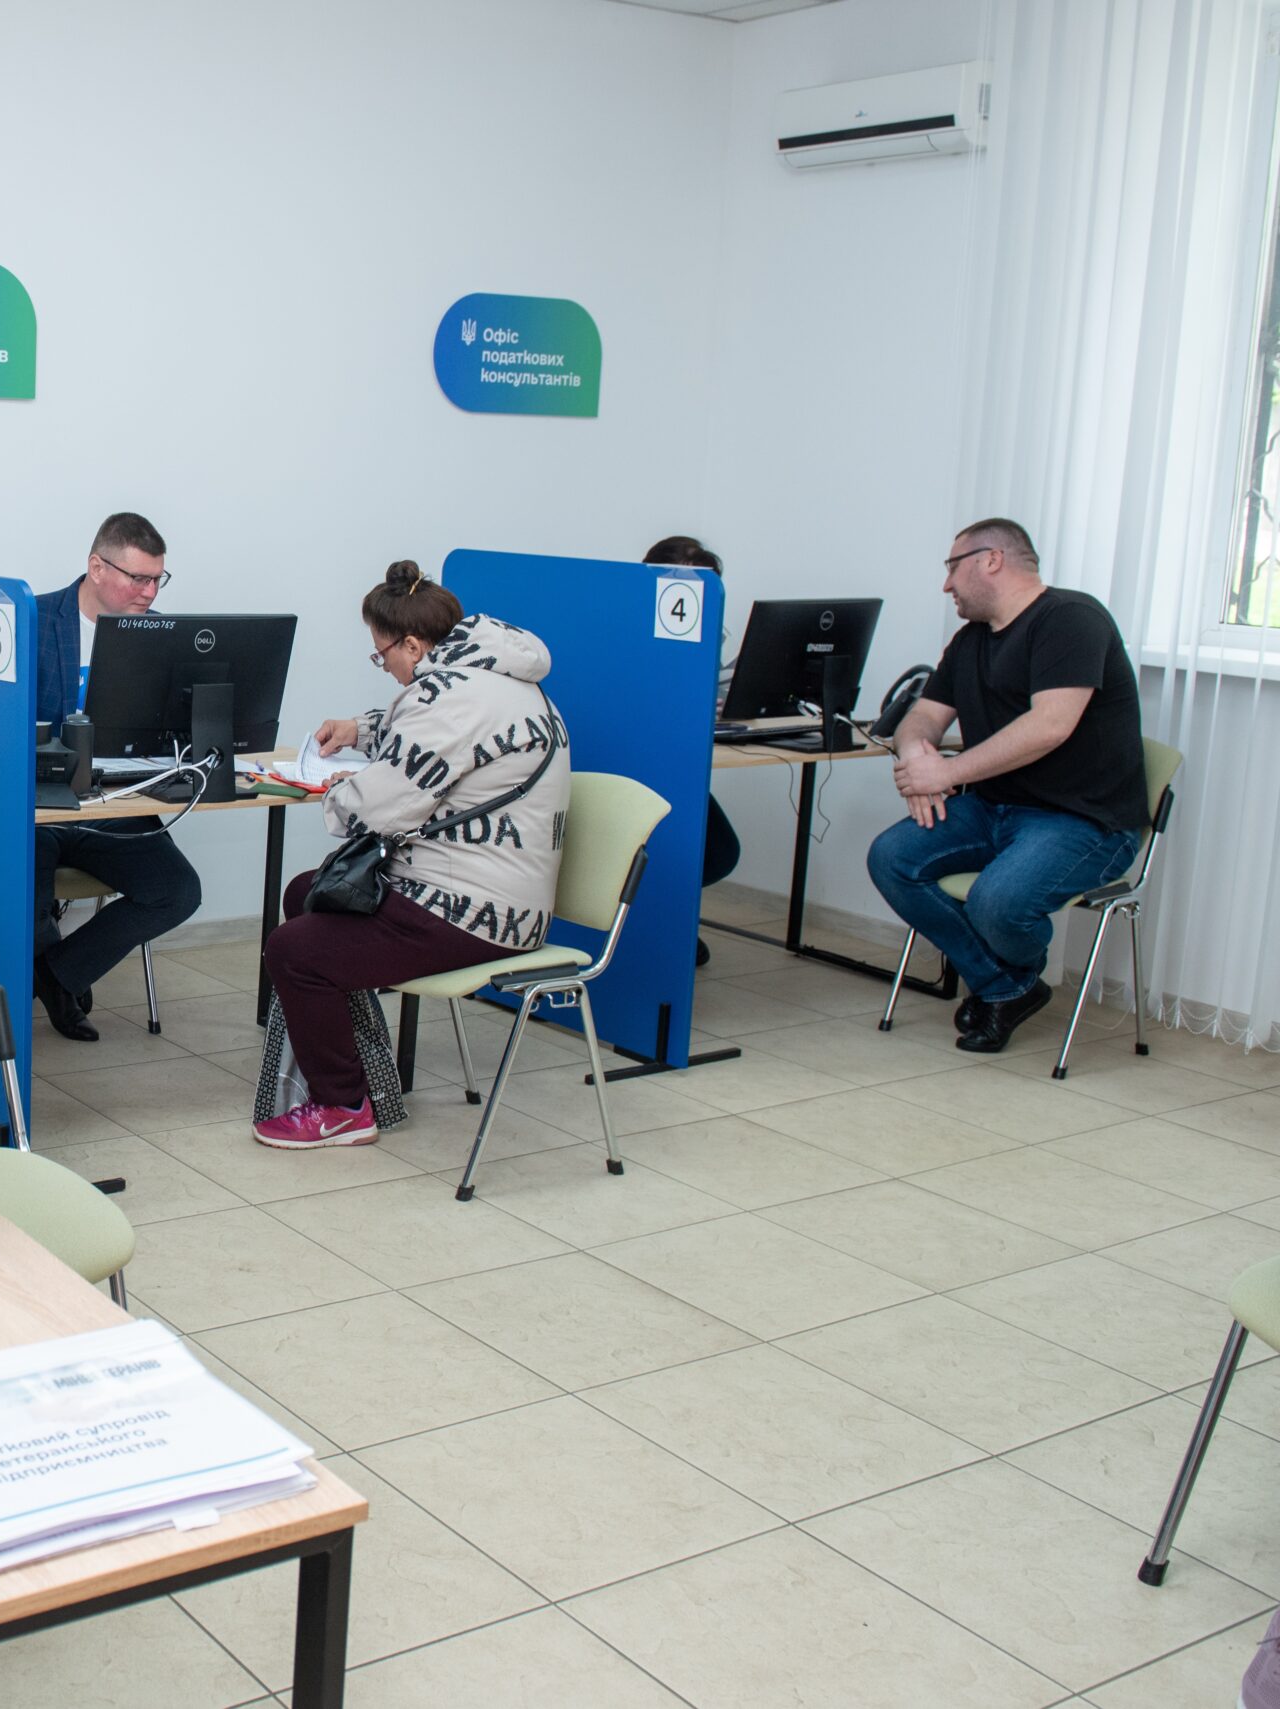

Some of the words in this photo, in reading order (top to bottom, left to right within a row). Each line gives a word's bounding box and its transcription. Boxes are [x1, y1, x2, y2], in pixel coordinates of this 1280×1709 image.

[483, 327, 519, 346] Офіс
[482, 350, 564, 367] податкових
[480, 368, 581, 387] консультантів
[670, 597, 687, 622] 4
[75, 1409, 171, 1437] супровід
